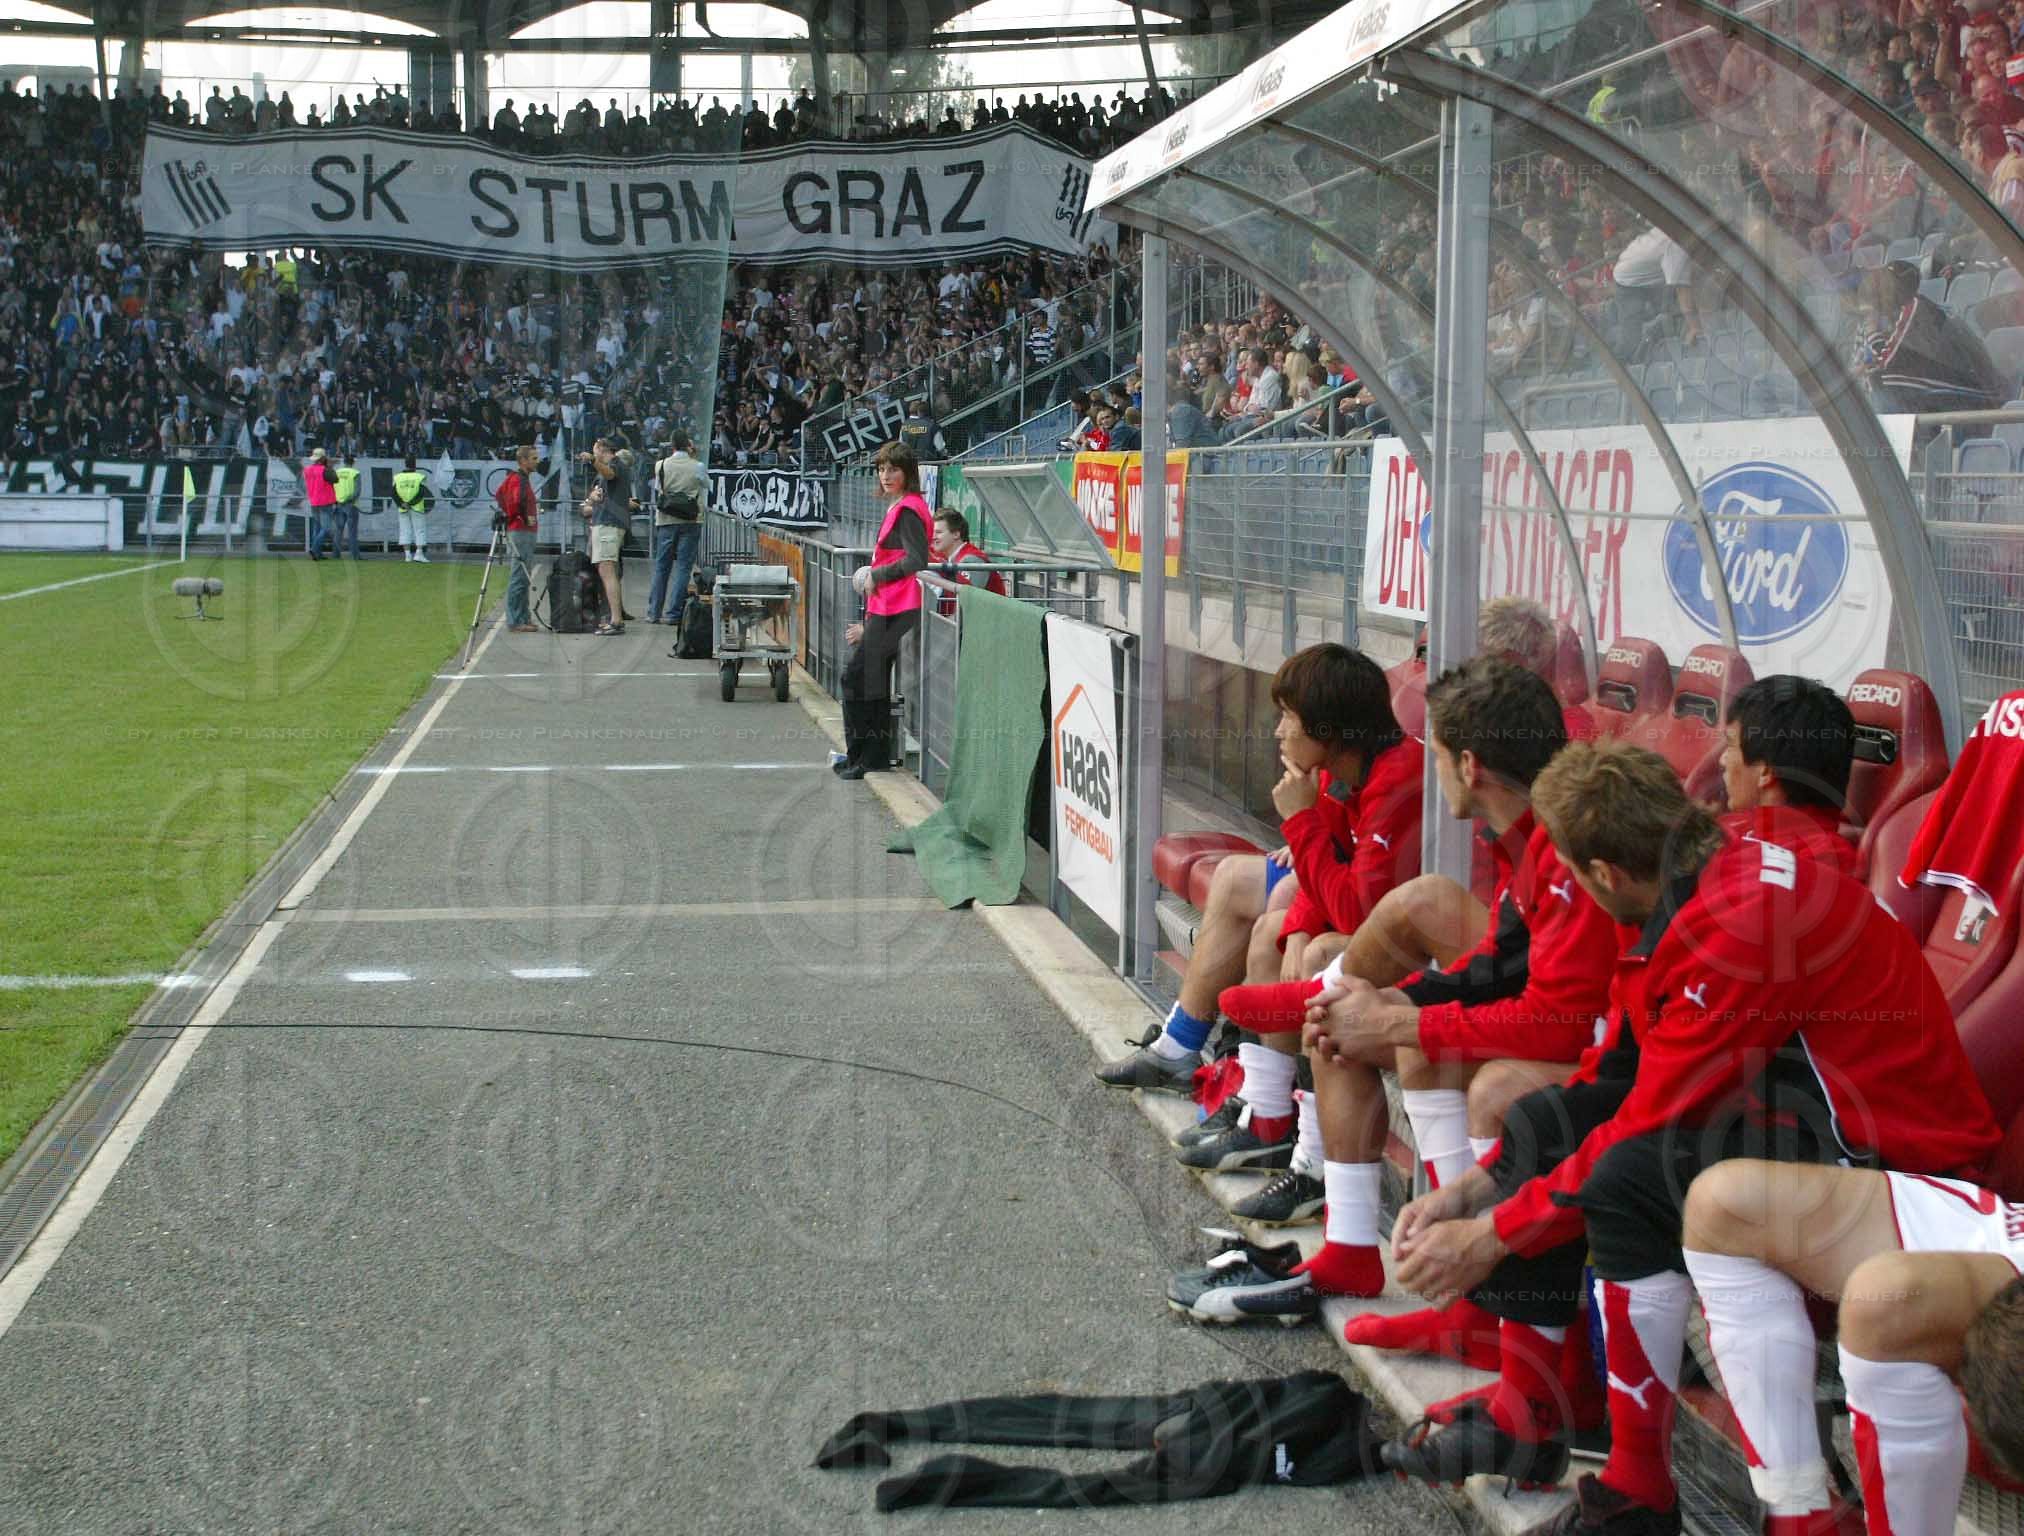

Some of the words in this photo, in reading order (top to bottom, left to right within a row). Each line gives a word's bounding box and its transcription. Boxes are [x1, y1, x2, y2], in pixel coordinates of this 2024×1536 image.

[311, 154, 415, 224] SK
[469, 168, 737, 246] STURM
[782, 160, 985, 238] GRAZ
[823, 392, 929, 460] GRA
[1481, 448, 1634, 640] ISINGER
[1700, 490, 1812, 612] Ford
[1607, 648, 1642, 668] RECARO
[1684, 656, 1725, 677] RECARO
[1850, 683, 1902, 707] RECARO
[1065, 803, 1114, 865] FERTIGBAU
